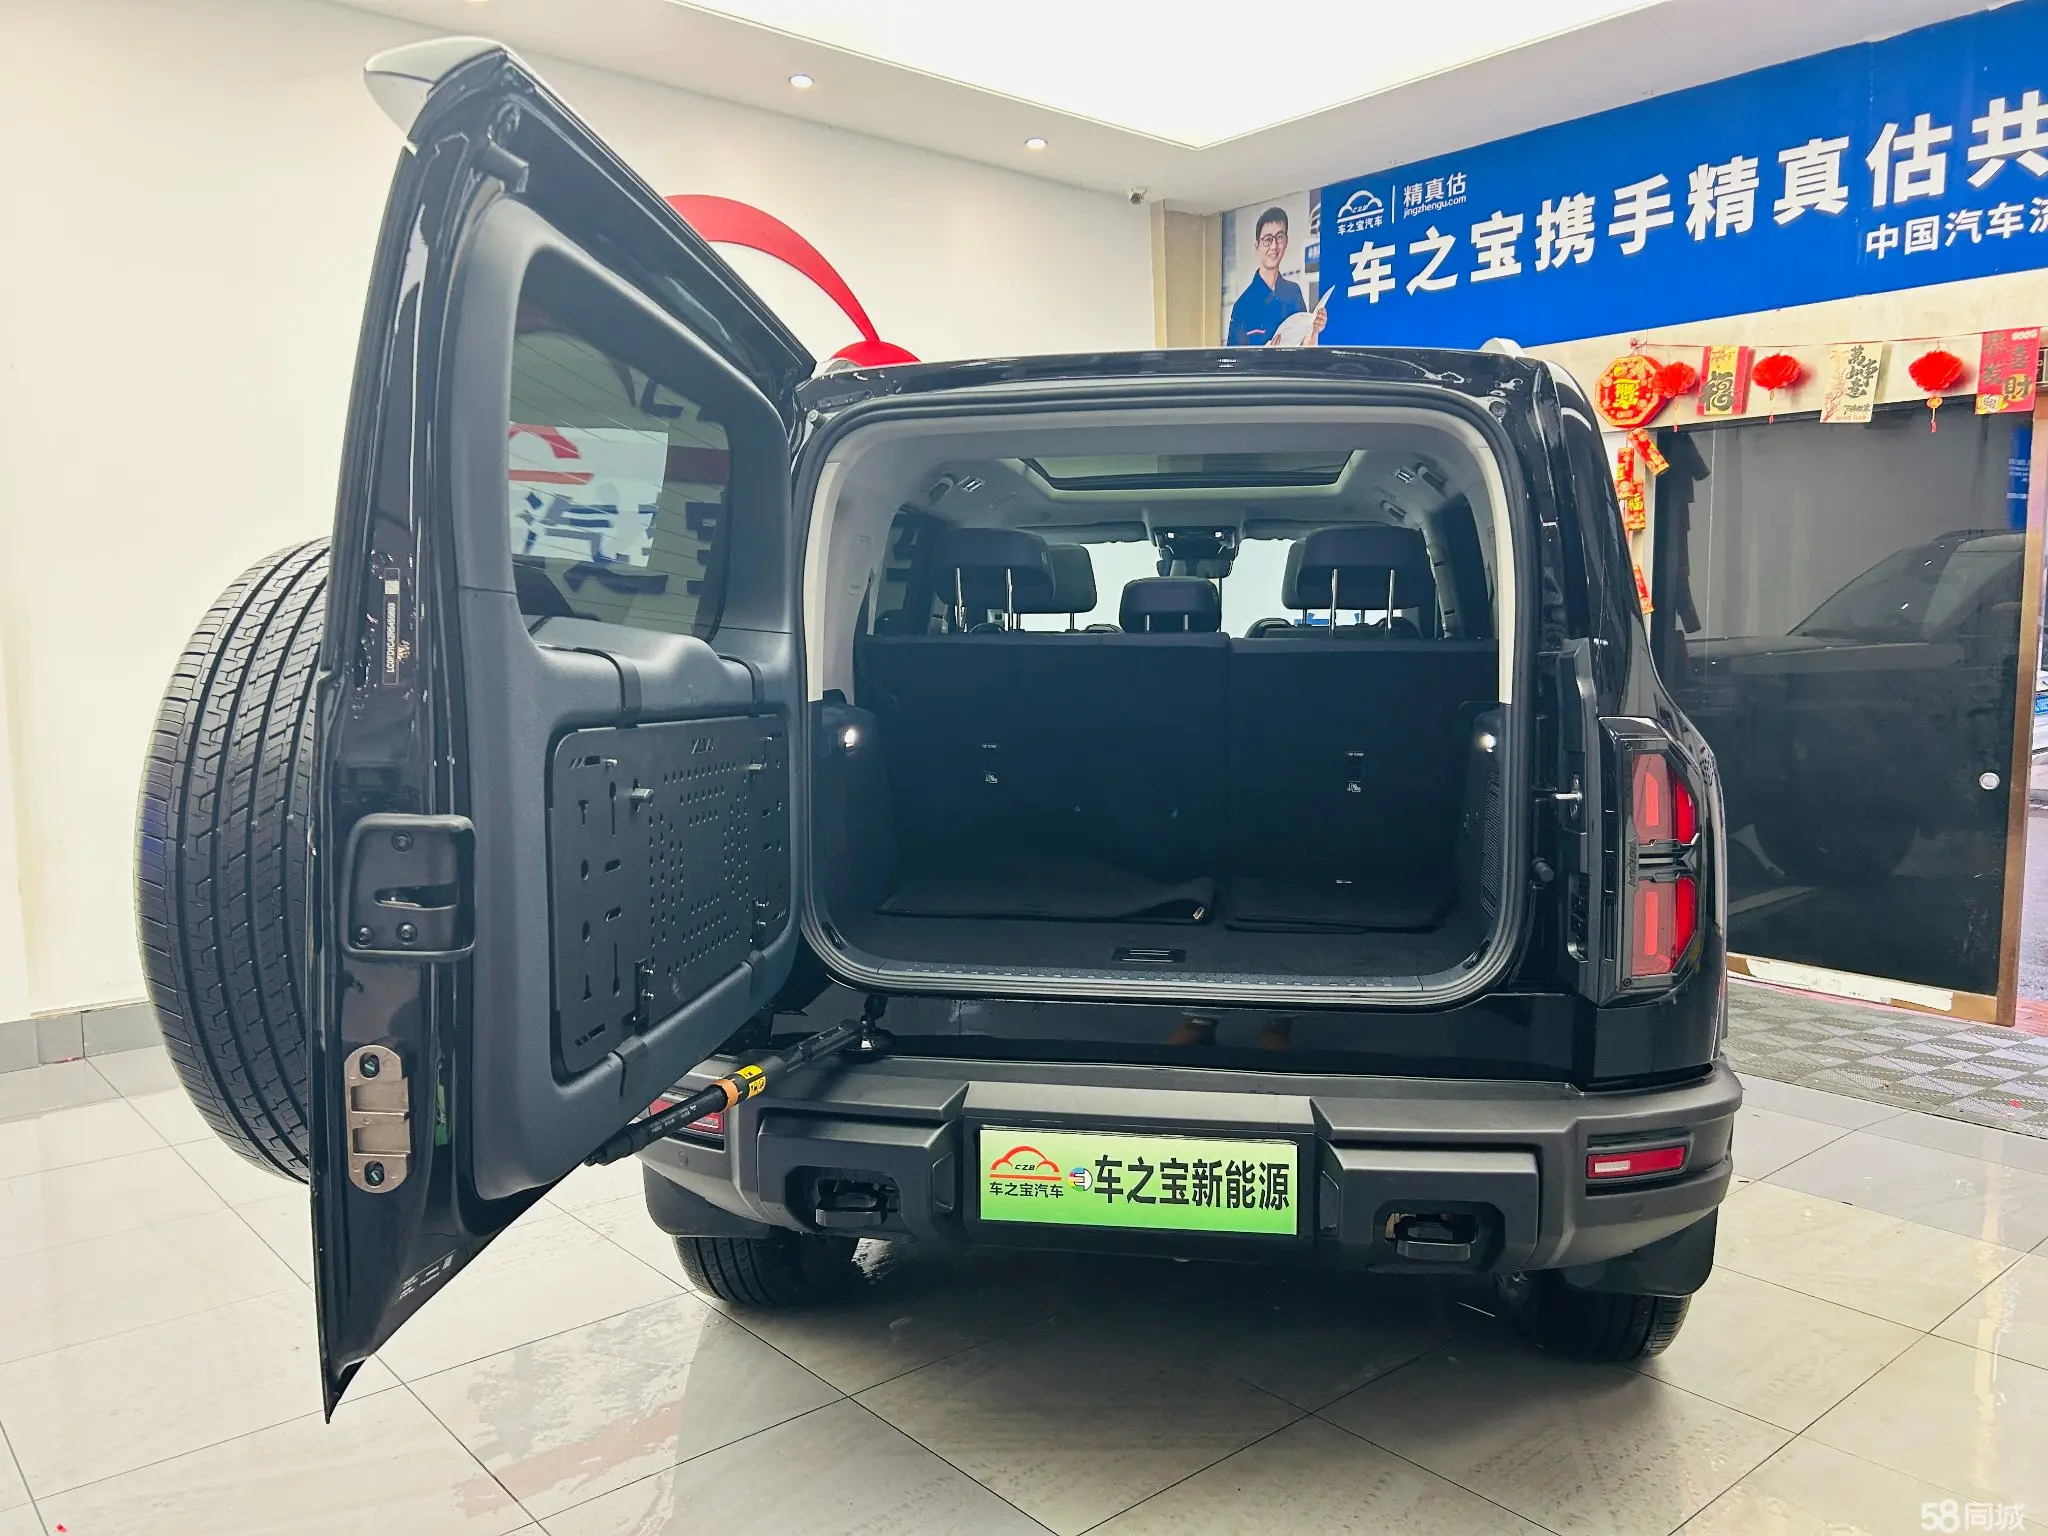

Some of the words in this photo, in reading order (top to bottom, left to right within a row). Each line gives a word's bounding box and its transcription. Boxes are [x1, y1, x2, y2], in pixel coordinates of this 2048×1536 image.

[1347, 90, 2048, 304] 车之宝携手精真估共
[1403, 172, 1467, 207] 精真估
[1402, 195, 1467, 219] jingzhengu.com
[1337, 215, 1383, 236] 车之宝汽车
[1014, 1163, 1036, 1171] CZB
[989, 1181, 1064, 1199] 车之宝汽车
[1095, 1155, 1290, 1211] 车之宝新能源
